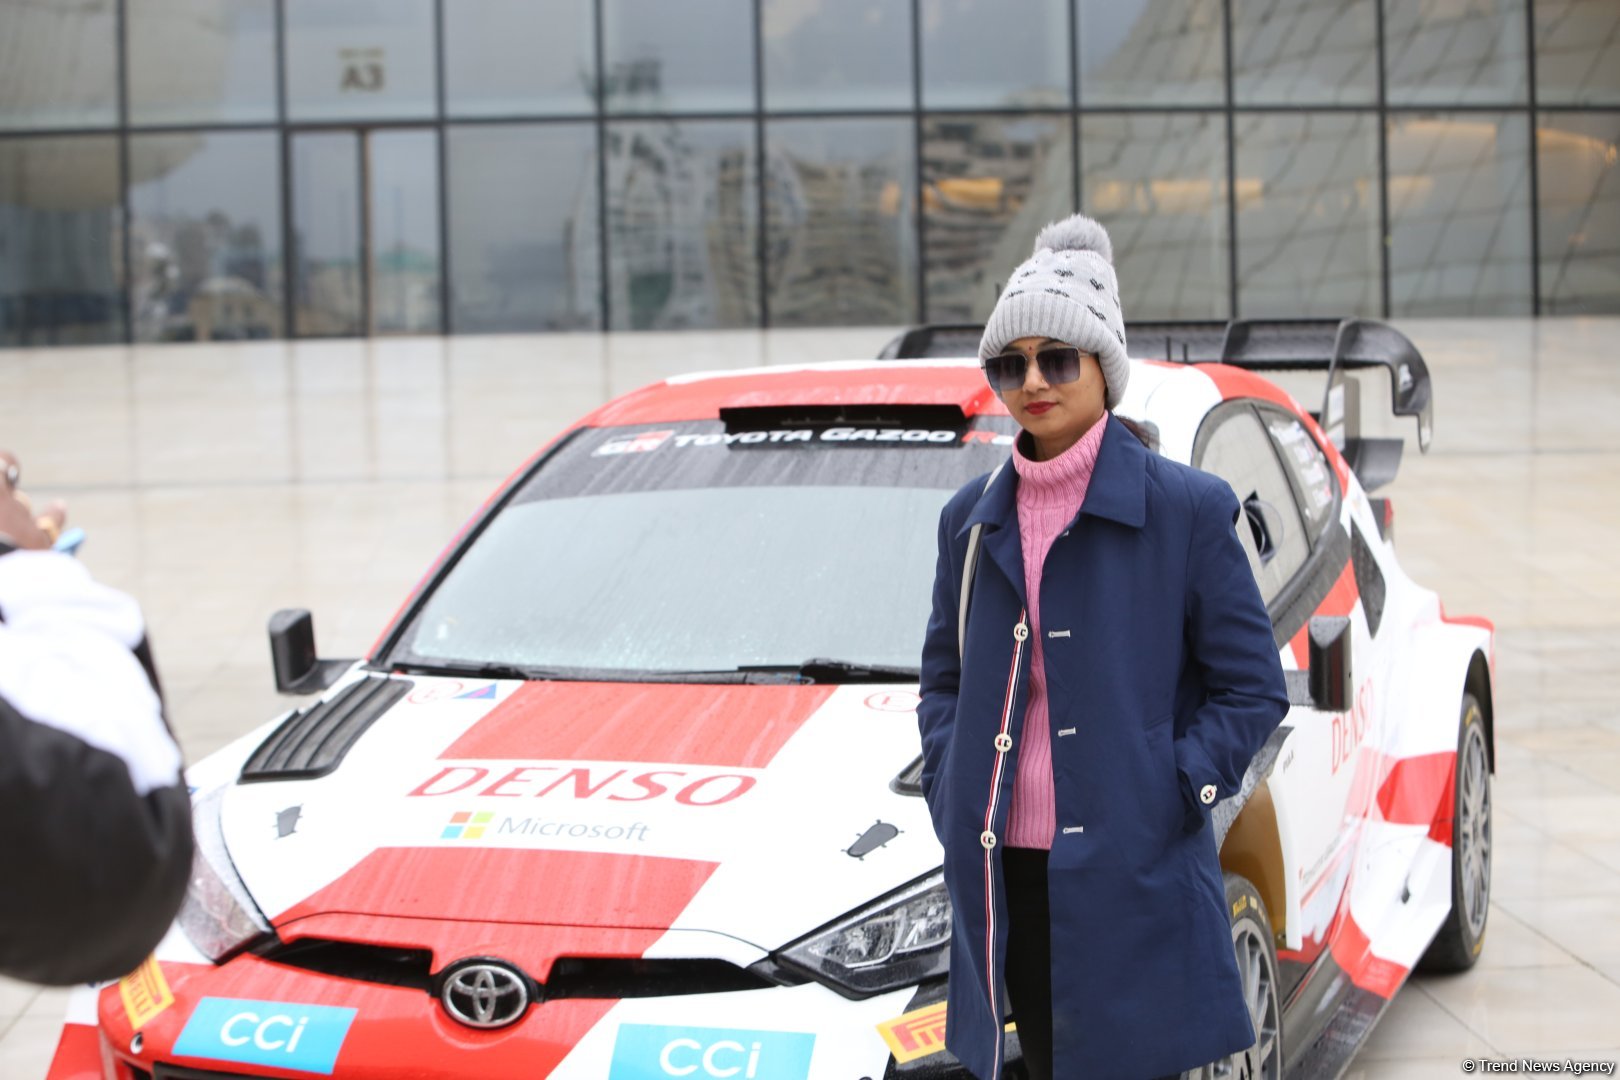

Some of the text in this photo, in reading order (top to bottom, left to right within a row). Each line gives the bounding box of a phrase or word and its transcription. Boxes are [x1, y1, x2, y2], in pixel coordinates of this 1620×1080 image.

[340, 63, 385, 92] A3
[675, 430, 813, 448] TOYOTA
[820, 427, 956, 443] GAZOO
[405, 767, 757, 806] DENSO
[497, 816, 650, 842] Microsoft
